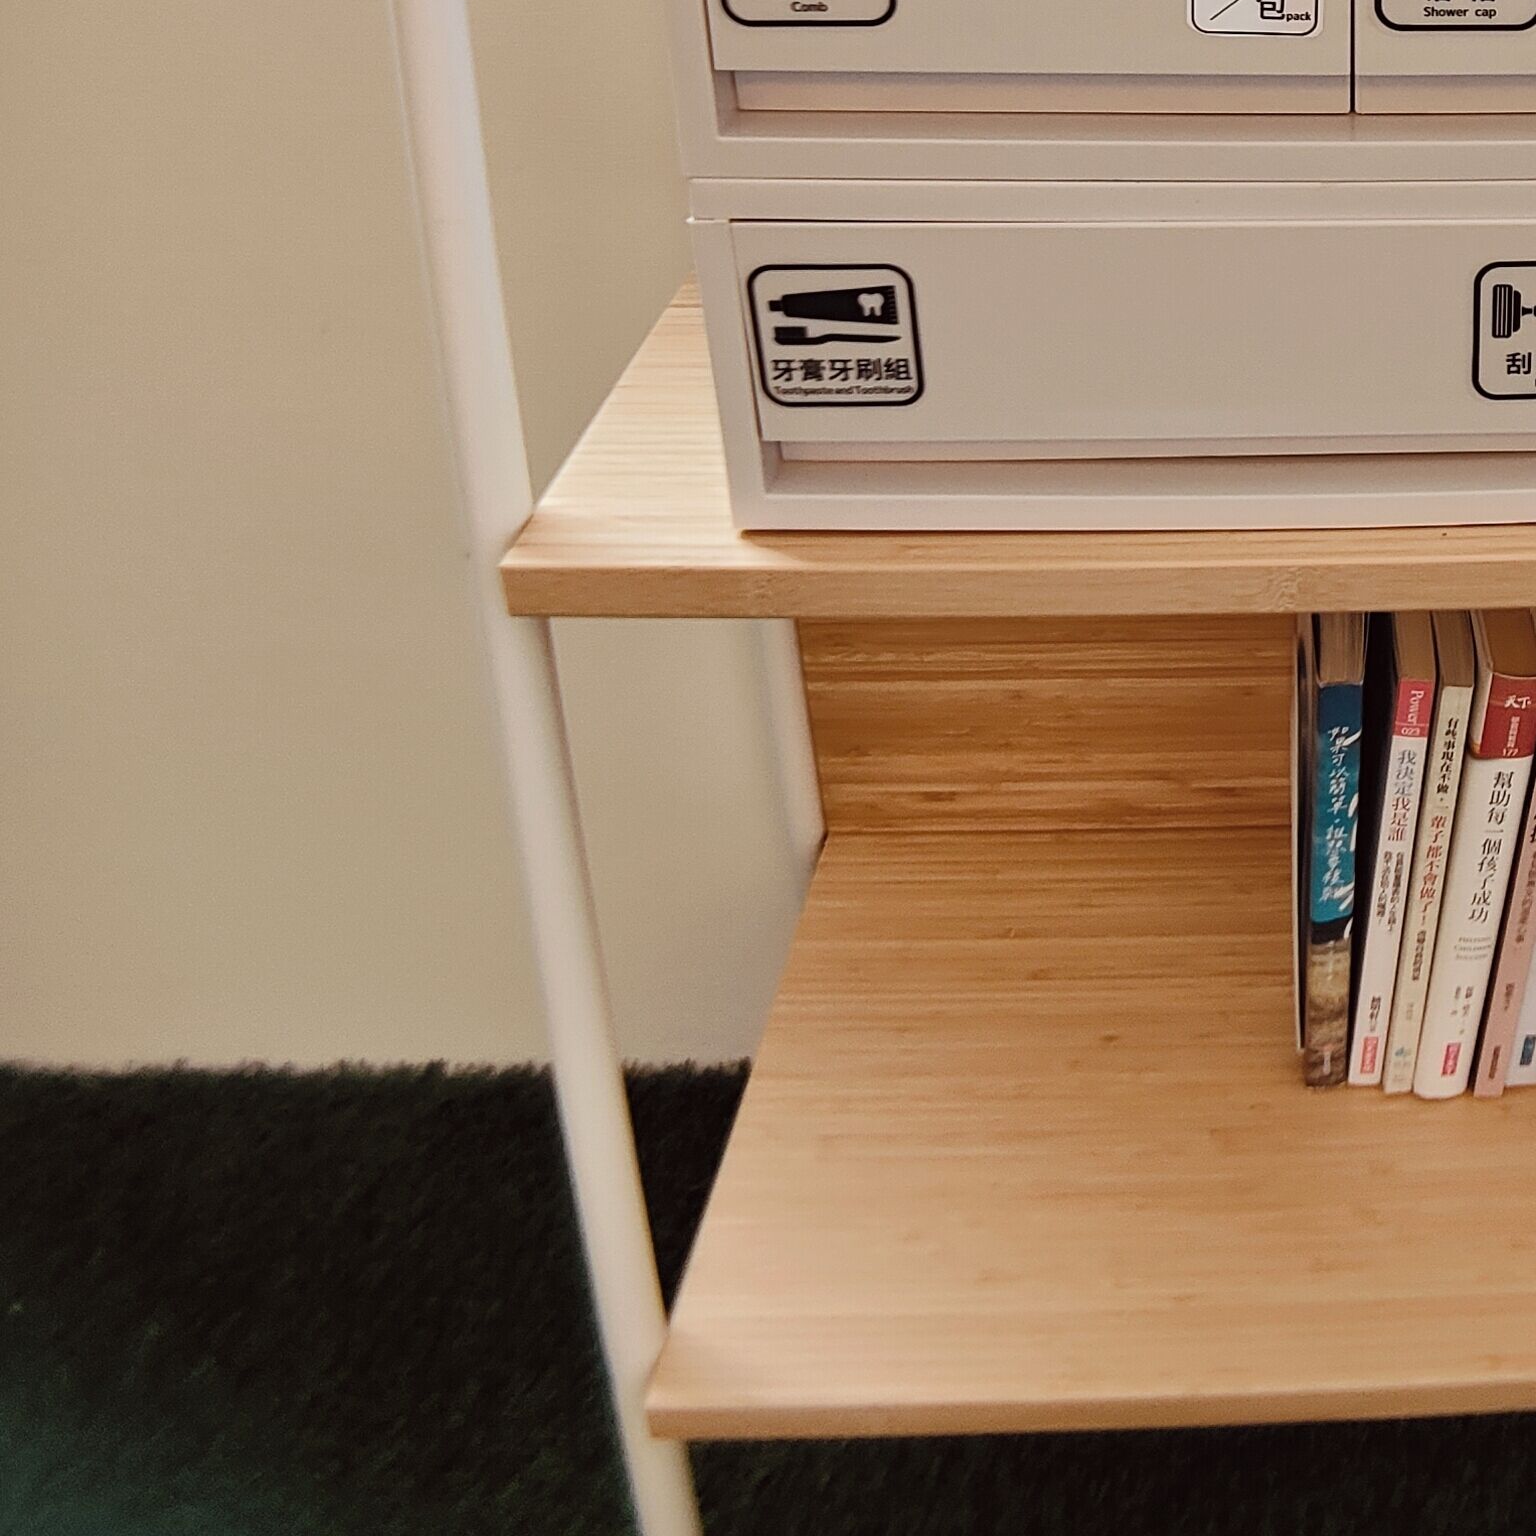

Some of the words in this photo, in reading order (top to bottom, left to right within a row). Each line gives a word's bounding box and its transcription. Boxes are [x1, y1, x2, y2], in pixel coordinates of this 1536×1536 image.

[790, 1, 829, 12] Comb
[1423, 6, 1469, 17] Shower
[1474, 8, 1497, 18] cap
[1286, 12, 1312, 22] pack
[771, 358, 912, 381] 牙膏牙刷組
[1407, 689, 1425, 725] Power
[1504, 694, 1532, 709] 天下
[1388, 750, 1417, 842] 我決定我是誰
[1468, 771, 1515, 924] 幫助每一個孩子成功
